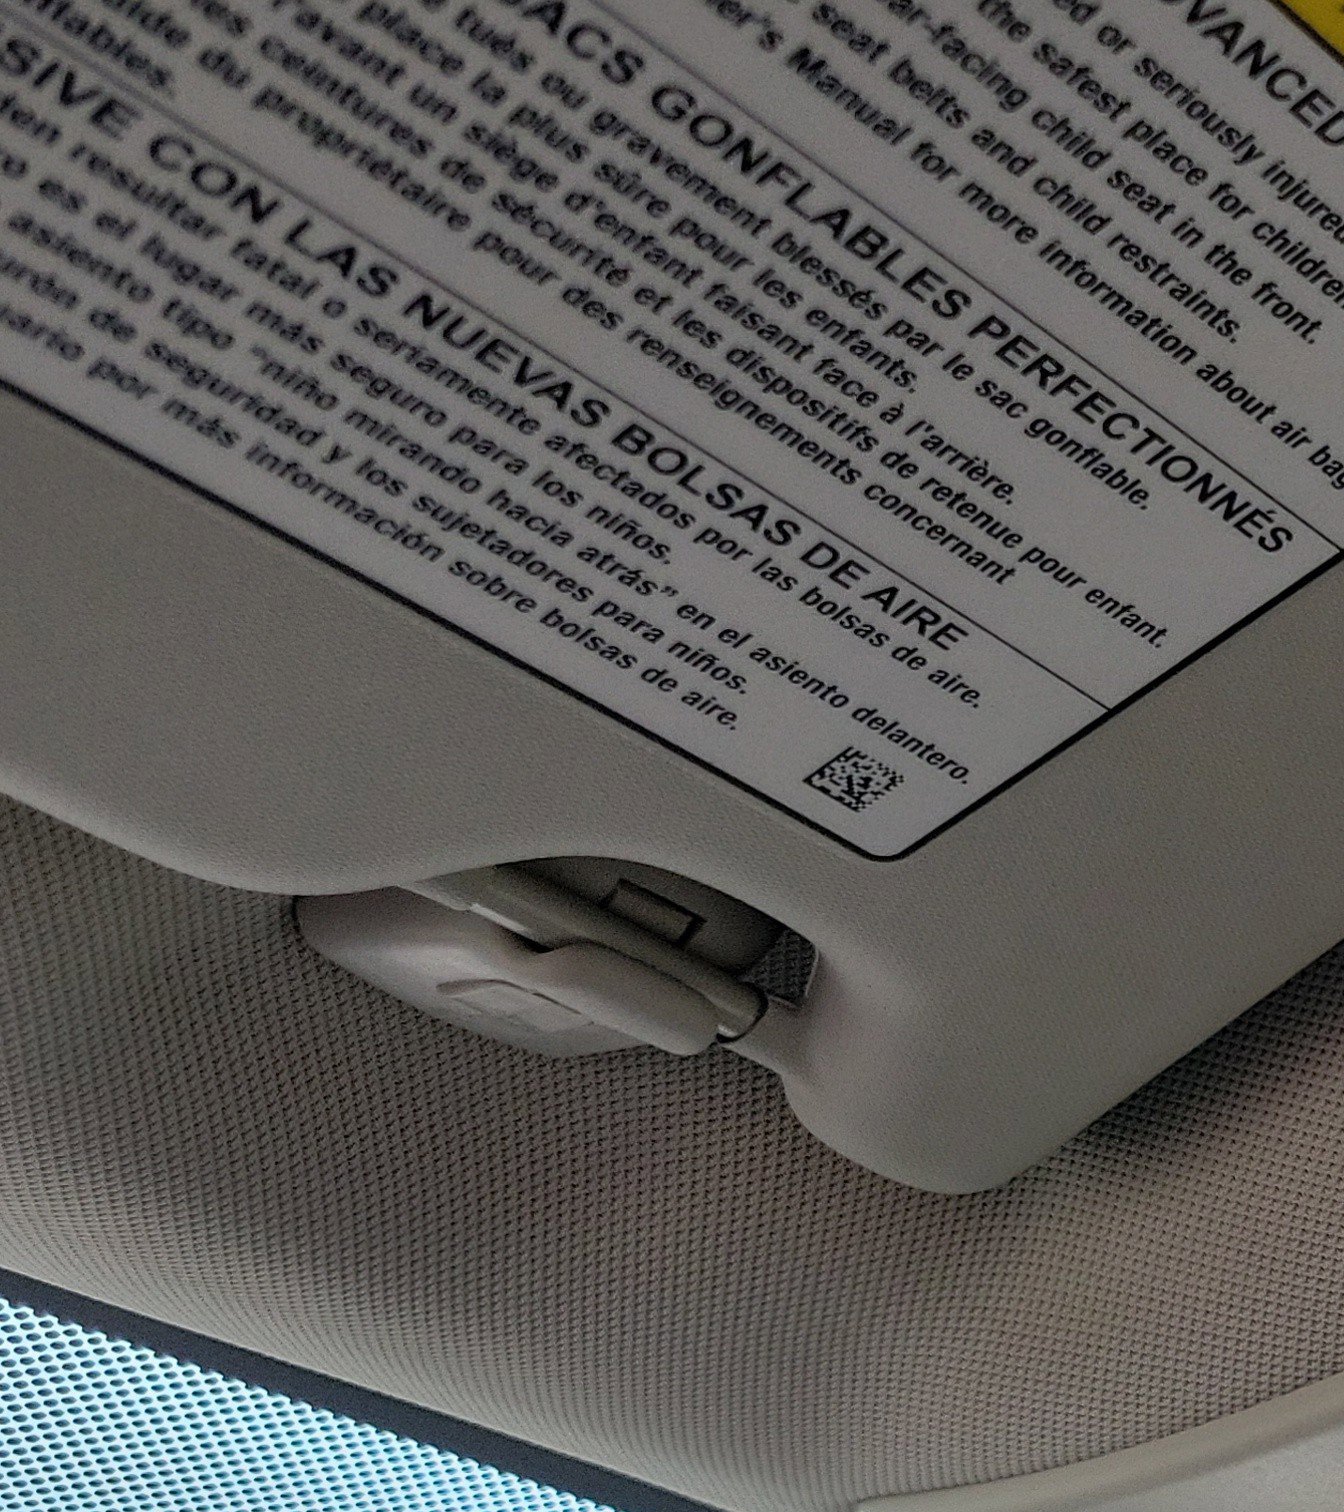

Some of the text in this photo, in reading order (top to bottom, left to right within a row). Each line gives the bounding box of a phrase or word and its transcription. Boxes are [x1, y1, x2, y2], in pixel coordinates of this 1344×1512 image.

[354, 1, 465, 77] place
[667, 214, 754, 271] pour
[751, 266, 803, 309] les
[803, 306, 917, 393] enfants.
[810, 1, 1240, 344] seat belts and child restraints.
[1031, 38, 1132, 123] safest
[1120, 117, 1208, 186] place
[1206, 180, 1255, 220] for
[1095, 21, 1136, 54] or
[1132, 53, 1265, 166] seriously
[498, 1, 1293, 552] ACS GONFLABLES PERFECTIONNÉS
[784, 43, 913, 146] Manual
[909, 139, 960, 182] for
[957, 180, 1038, 244] more
[1037, 238, 1198, 365] information
[1194, 362, 1277, 424] about
[1269, 419, 1312, 449] air
[1029, 107, 1113, 171] child
[1105, 167, 1176, 224] seat
[1170, 215, 1205, 248] in
[1203, 242, 1253, 286] the
[1250, 280, 1322, 344] front.
[146, 133, 282, 226] CON
[282, 216, 400, 298] LAS
[401, 290, 611, 428] NUEVAS
[609, 421, 801, 546] BOLSAS
[798, 540, 870, 589] DE
[860, 584, 969, 651] AIRE
[624, 325, 862, 485] renseignements
[862, 482, 1016, 585] concernant
[632, 284, 673, 315] et
[671, 306, 723, 349] les
[723, 345, 879, 452] dispositifs
[878, 450, 919, 479] de
[918, 475, 1023, 548] retenue
[1017, 545, 1087, 588] pour
[1084, 587, 1167, 648] enfant.
[702, 281, 815, 363] faisant
[811, 356, 879, 408] face
[878, 401, 904, 425] à
[903, 418, 1014, 505] l'arrière.
[769, 229, 888, 320] blessés
[881, 317, 944, 357] par
[940, 351, 974, 381] le
[973, 378, 1029, 419] sac
[1023, 417, 1149, 510] gonflable.
[639, 666, 678, 692] de
[680, 690, 737, 730] aire.
[666, 640, 746, 694] niños.
[675, 602, 716, 630] en
[717, 627, 753, 649] el
[748, 646, 849, 708] asiento
[850, 706, 969, 784] delantero.
[692, 526, 753, 560] por
[750, 555, 798, 592] las
[798, 584, 890, 647] bolsas
[890, 645, 927, 670] de
[926, 668, 980, 708] aire.
